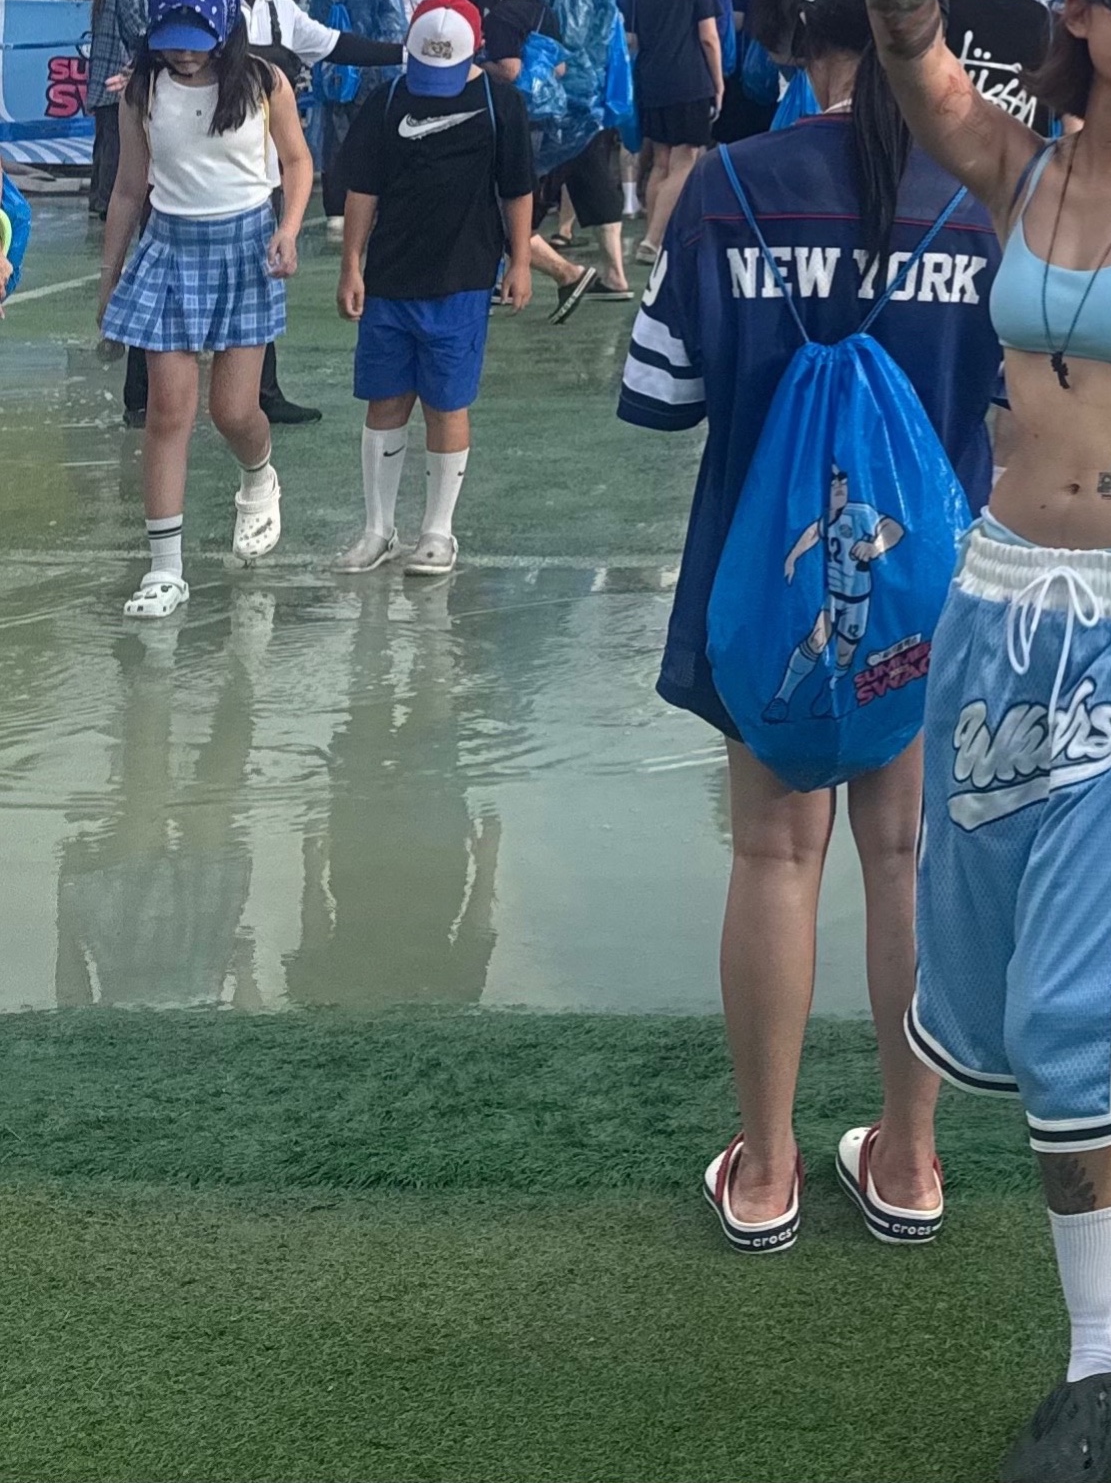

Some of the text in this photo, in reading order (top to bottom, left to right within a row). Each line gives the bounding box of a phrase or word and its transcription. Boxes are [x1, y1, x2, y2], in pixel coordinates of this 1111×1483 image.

[726, 247, 841, 298] NEW
[853, 248, 988, 305] YORK
[854, 642, 931, 689] SUMME
[752, 1229, 793, 1248] crocs
[892, 1223, 932, 1236] crocs
